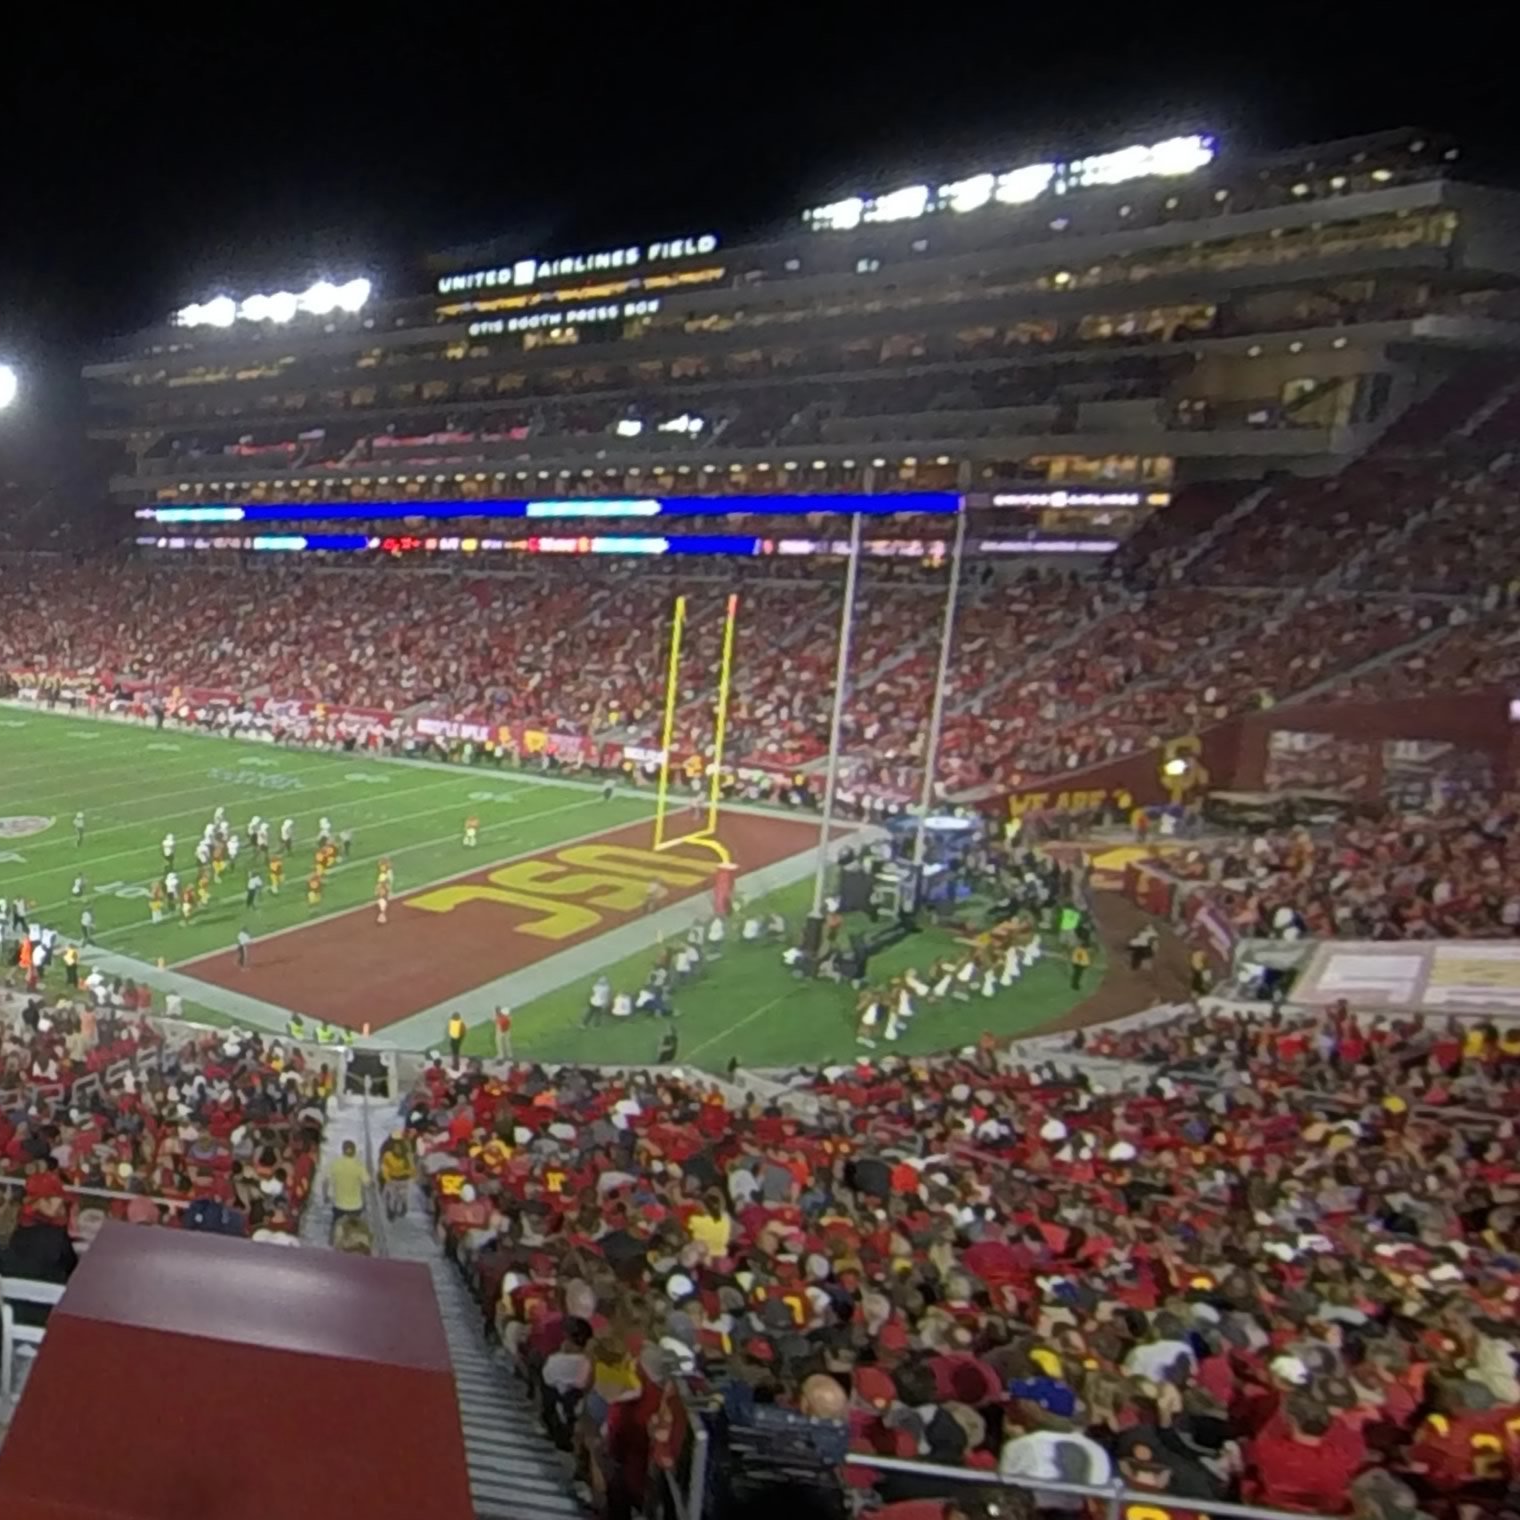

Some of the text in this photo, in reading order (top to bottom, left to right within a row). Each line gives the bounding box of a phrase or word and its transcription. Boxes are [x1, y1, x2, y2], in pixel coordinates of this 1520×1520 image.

[438, 234, 718, 294] UNITED AIRLINES FIELD
[468, 299, 660, 336] OTIS BOOTH PRESS BOX
[403, 843, 720, 940] USC
